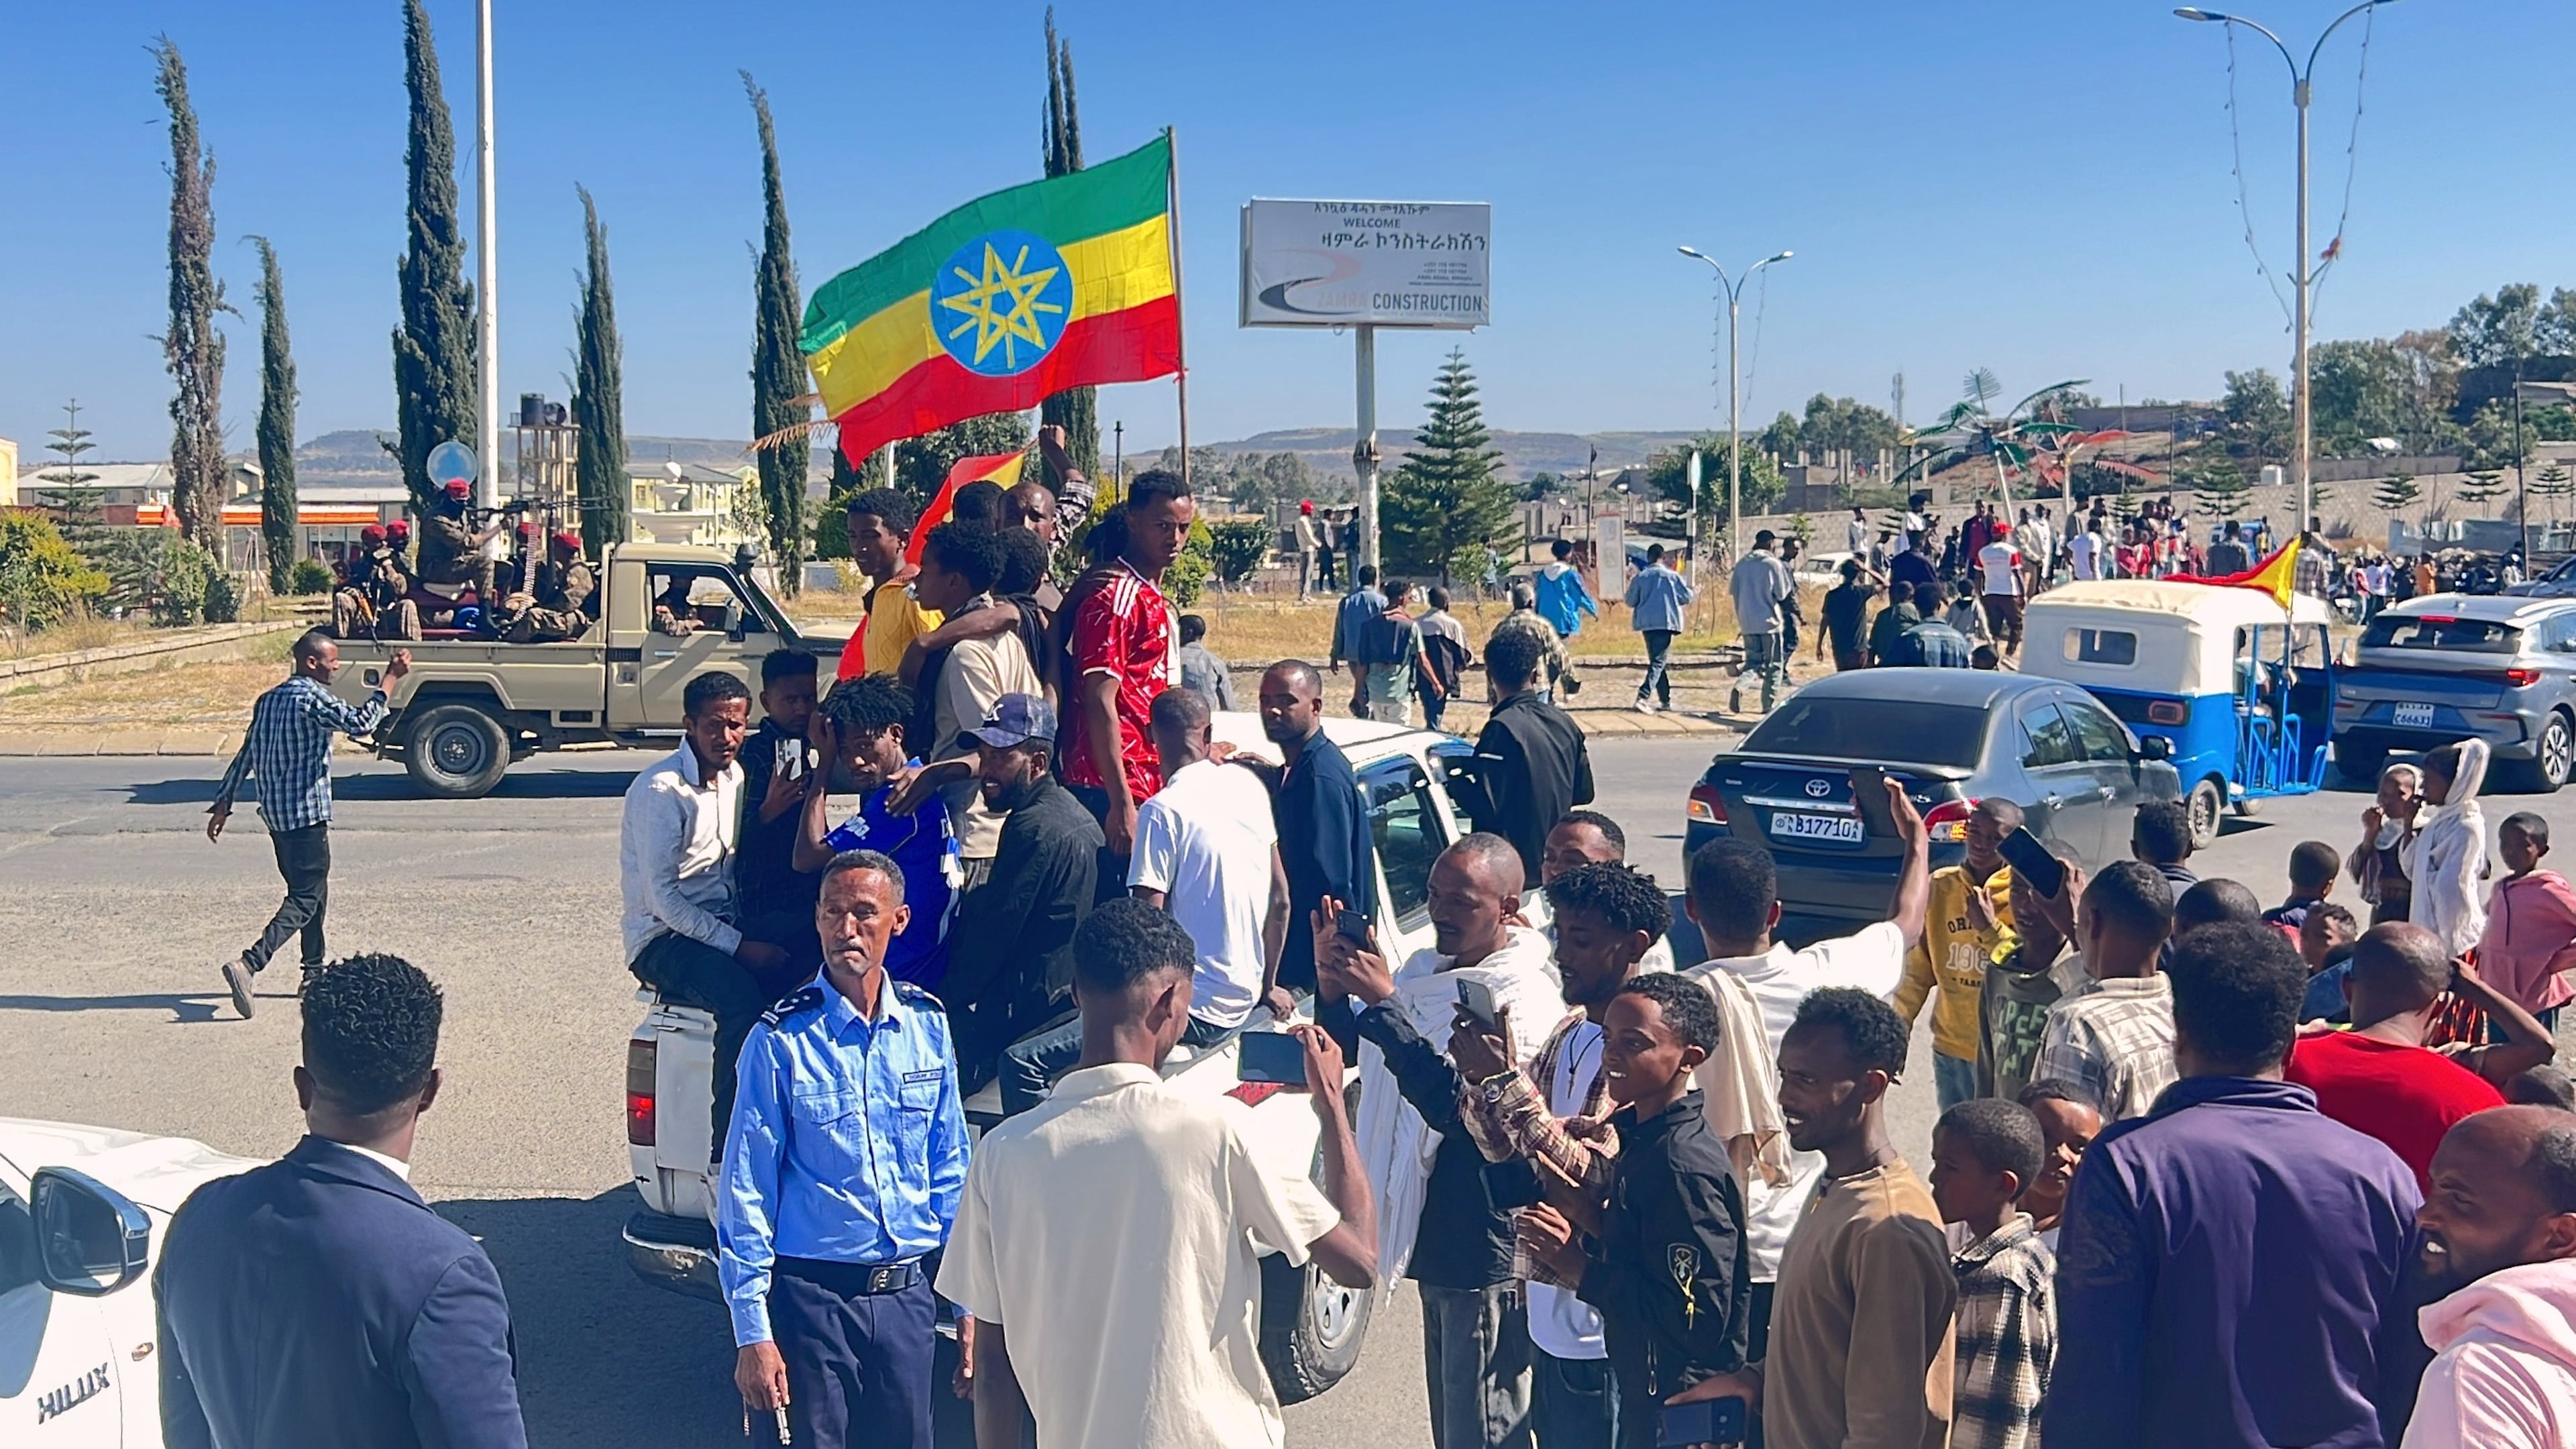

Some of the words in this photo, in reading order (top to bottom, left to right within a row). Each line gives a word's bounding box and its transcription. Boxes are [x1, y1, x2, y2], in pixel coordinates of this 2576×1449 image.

[1344, 218, 1401, 229] WELCOME
[1322, 232, 1369, 248] ዛምራ
[1376, 232, 1486, 251] ኮንስትራክሽን
[1318, 292, 1366, 308] ZAMRA
[1373, 293, 1482, 311] CONSTRUCTION
[1796, 817, 1851, 837] B17710
[37, 1362, 110, 1425] HILUX
